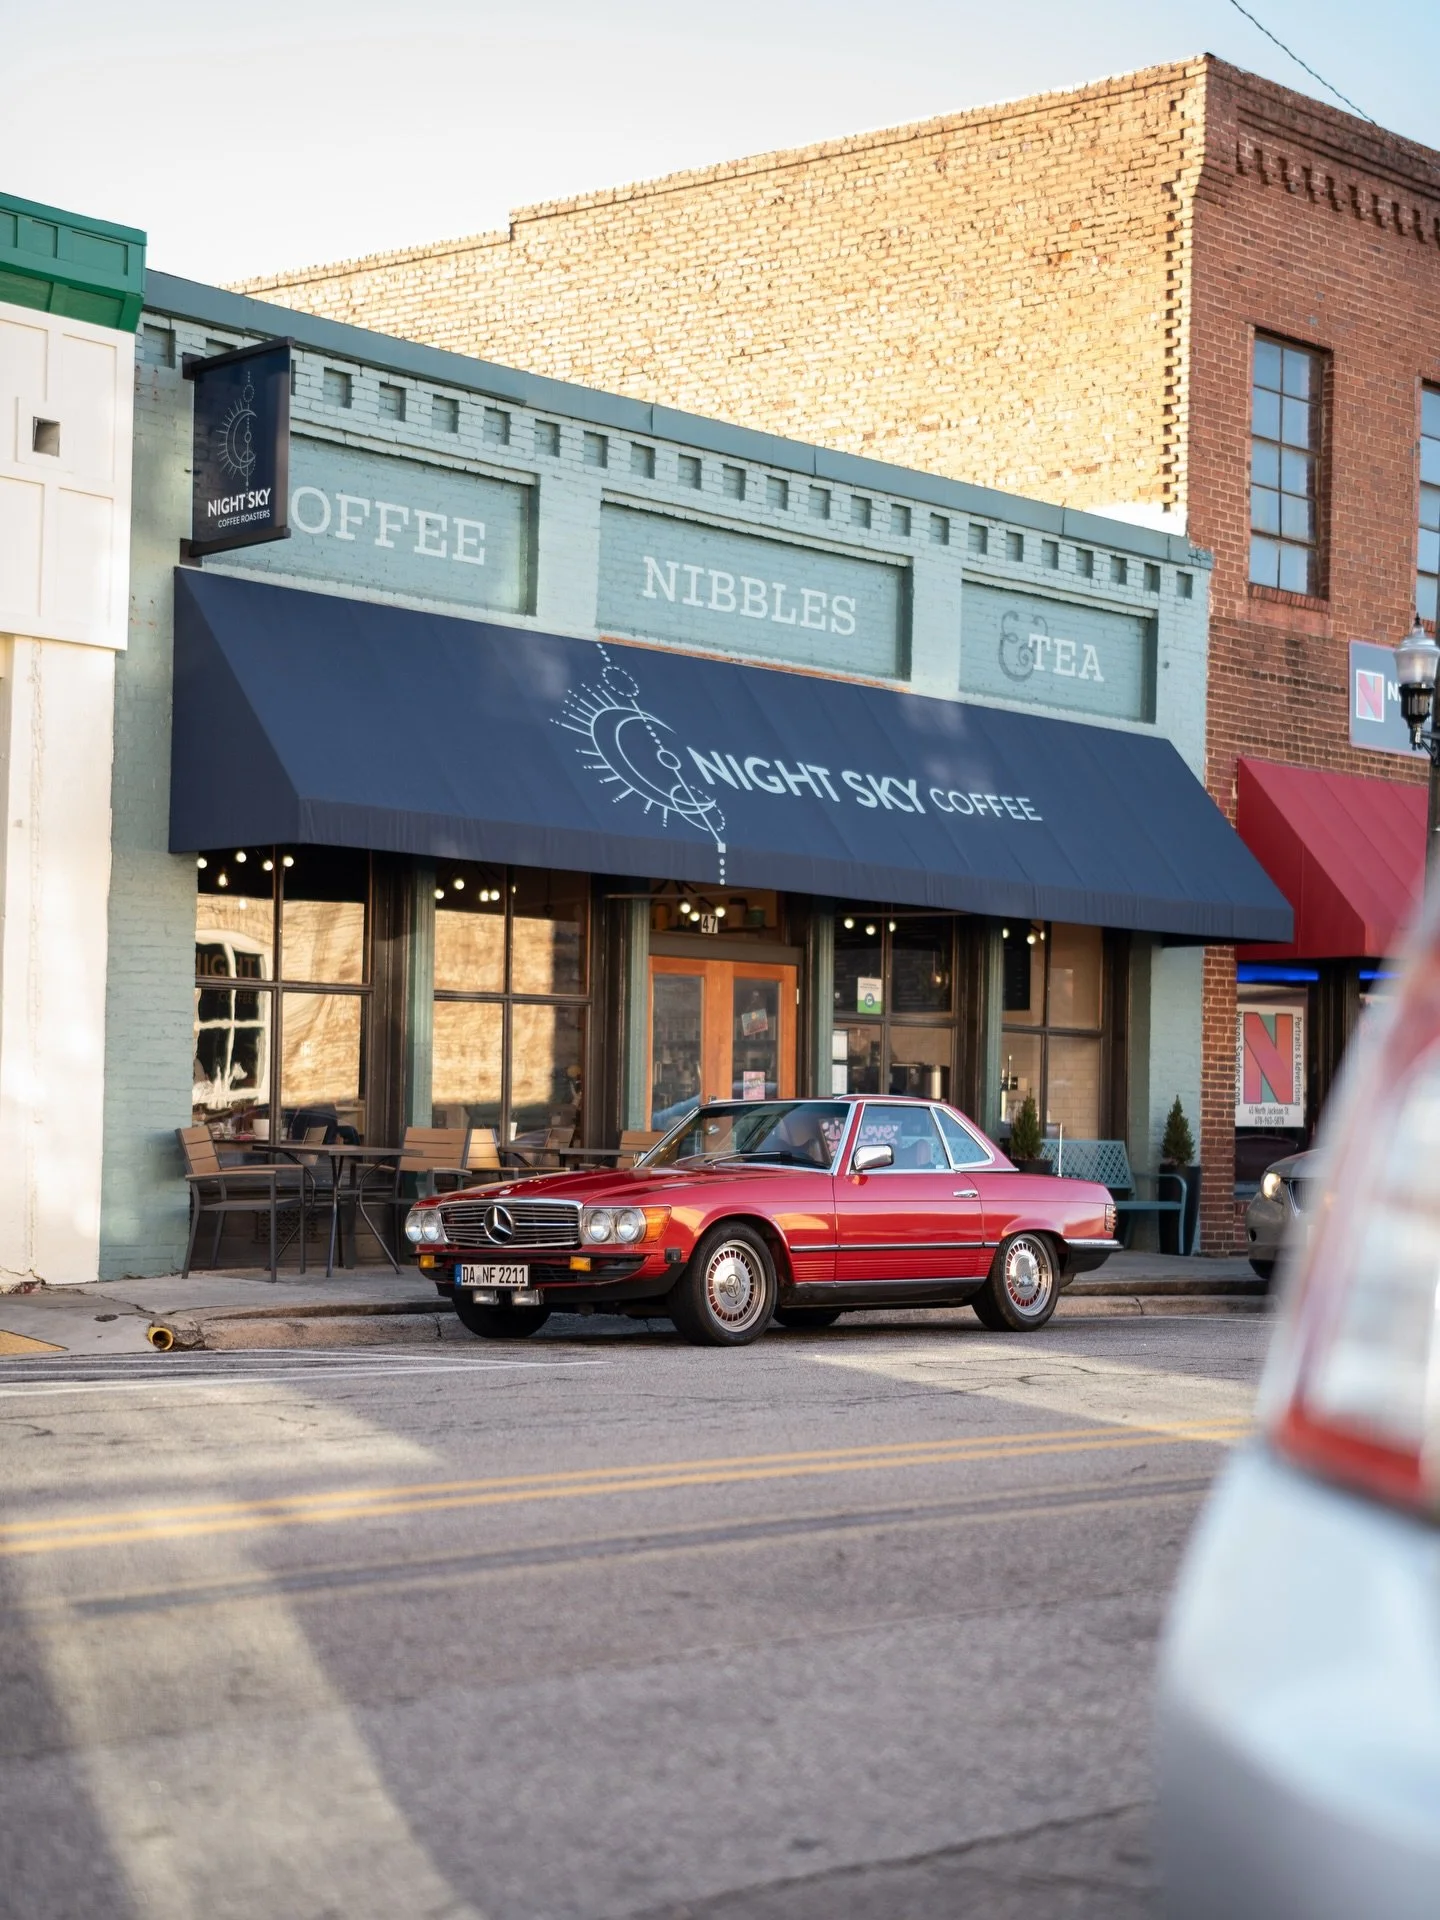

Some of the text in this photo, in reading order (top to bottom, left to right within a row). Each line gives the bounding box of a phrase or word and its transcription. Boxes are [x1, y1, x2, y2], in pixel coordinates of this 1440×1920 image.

[207, 487, 272, 518] NIGHT SKY
[218, 509, 271, 528] COFFEE ROASTERS
[290, 486, 485, 566] OFFEE
[642, 556, 857, 636] NIBBLES
[1028, 633, 1105, 683] TEA
[686, 746, 1043, 822] NIGHT SKY COFFEE
[702, 915, 717, 933] 47
[195, 952, 256, 977] IGHT
[1235, 1045, 1243, 1106] Sanderscom
[1294, 1061, 1302, 1106] Advertising
[1254, 1105, 1266, 1115] North
[1267, 1105, 1283, 1116] Jackson
[462, 1266, 475, 1283] DA
[483, 1266, 496, 1283] NF
[499, 1267, 525, 1283] 2211
